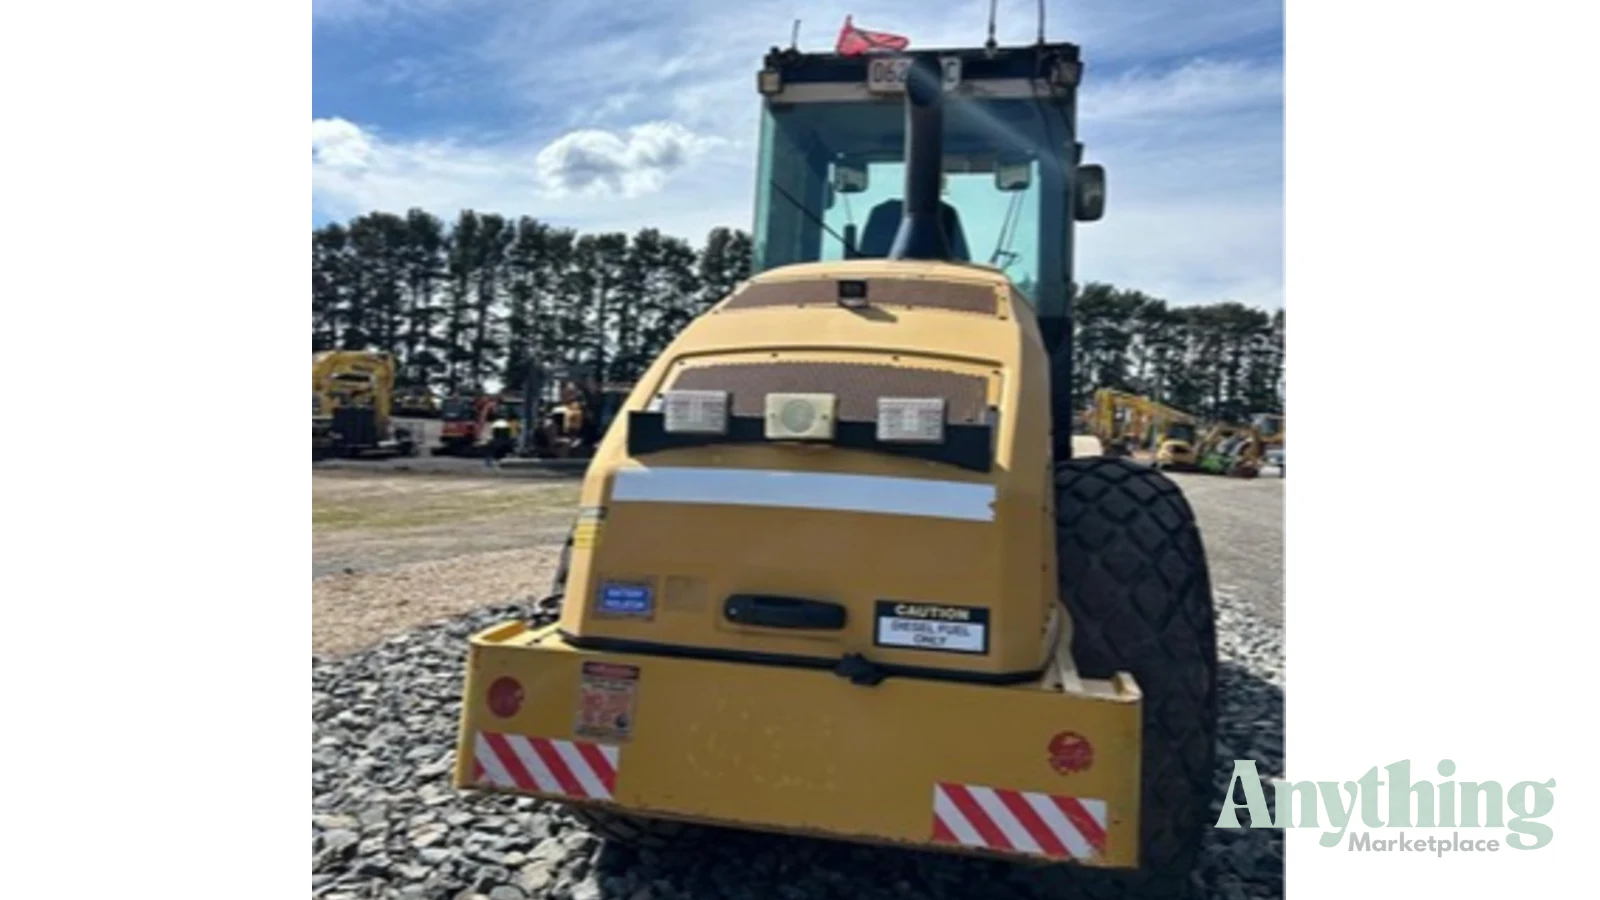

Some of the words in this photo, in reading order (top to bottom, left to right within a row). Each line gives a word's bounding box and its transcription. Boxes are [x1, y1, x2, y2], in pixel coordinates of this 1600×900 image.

[894, 603, 971, 620] CAUTION
[890, 619, 935, 634] DIESEL
[938, 623, 972, 637] FUEL
